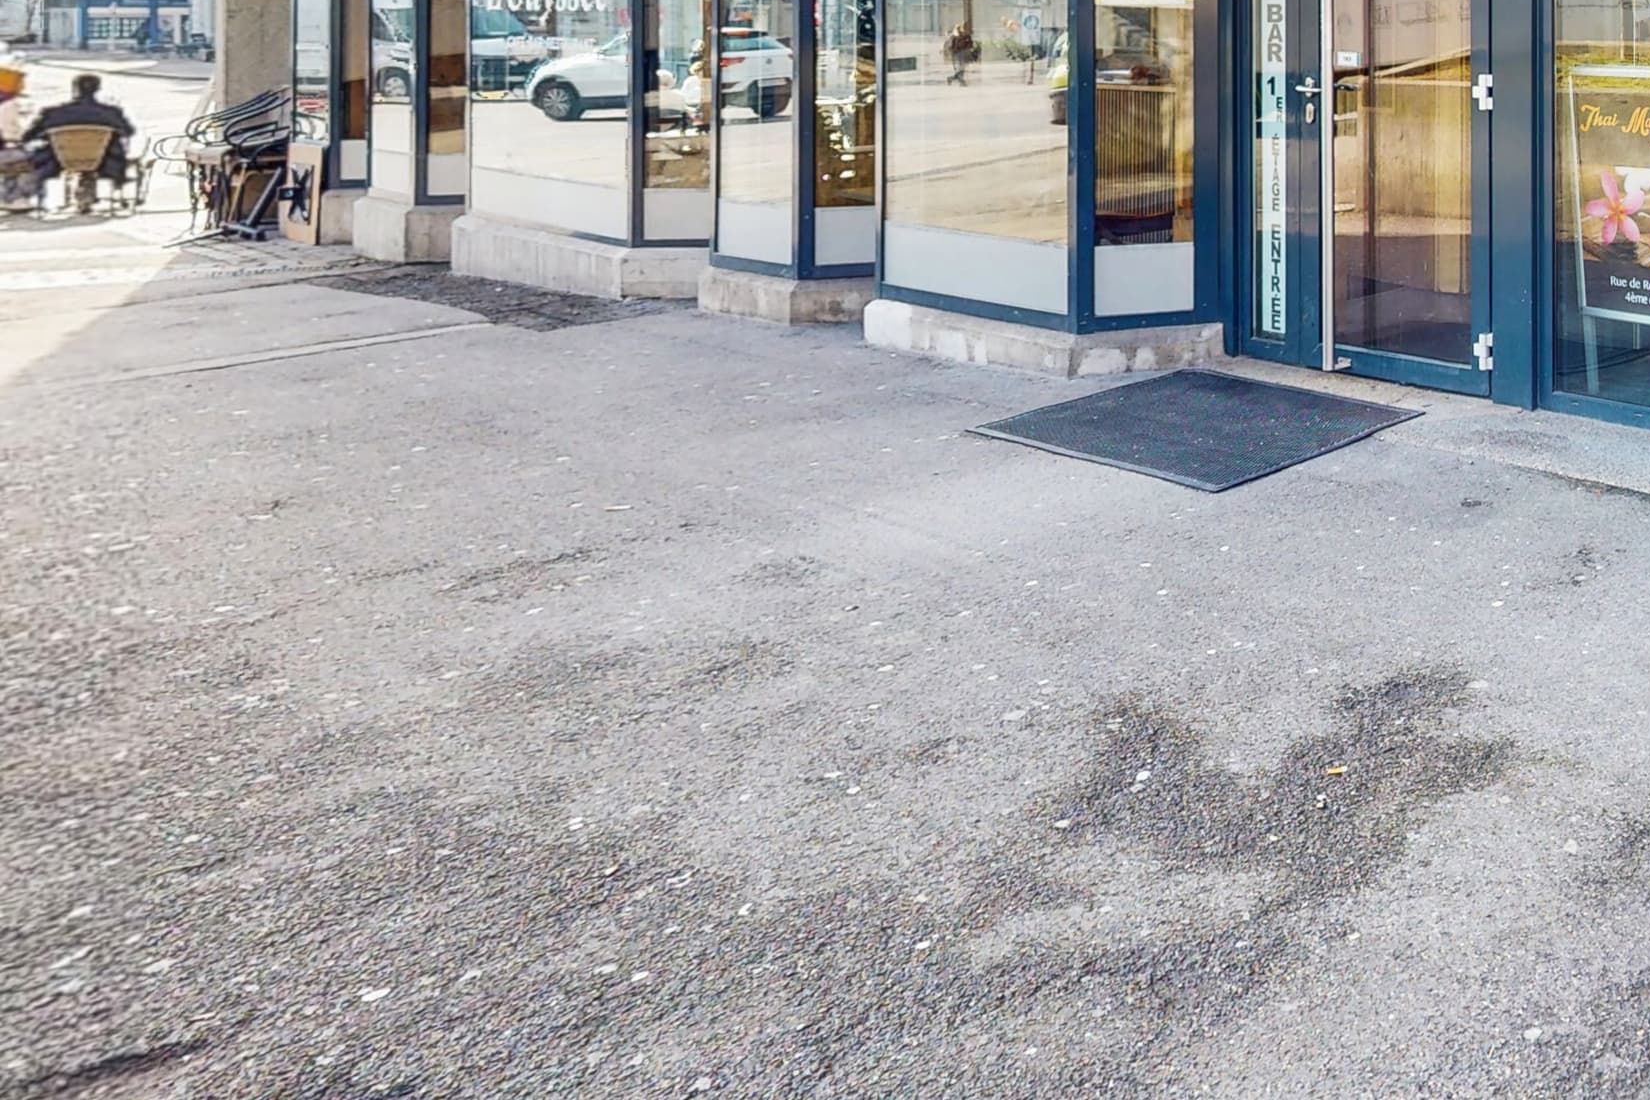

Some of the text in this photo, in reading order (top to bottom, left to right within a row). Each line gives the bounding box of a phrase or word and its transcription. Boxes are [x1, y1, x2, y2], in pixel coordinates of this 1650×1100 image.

[1266, 3, 1284, 63] BAR
[1580, 104, 1619, 132] Thai
[1609, 275, 1628, 288] Rue
[1629, 276, 1641, 290] de
